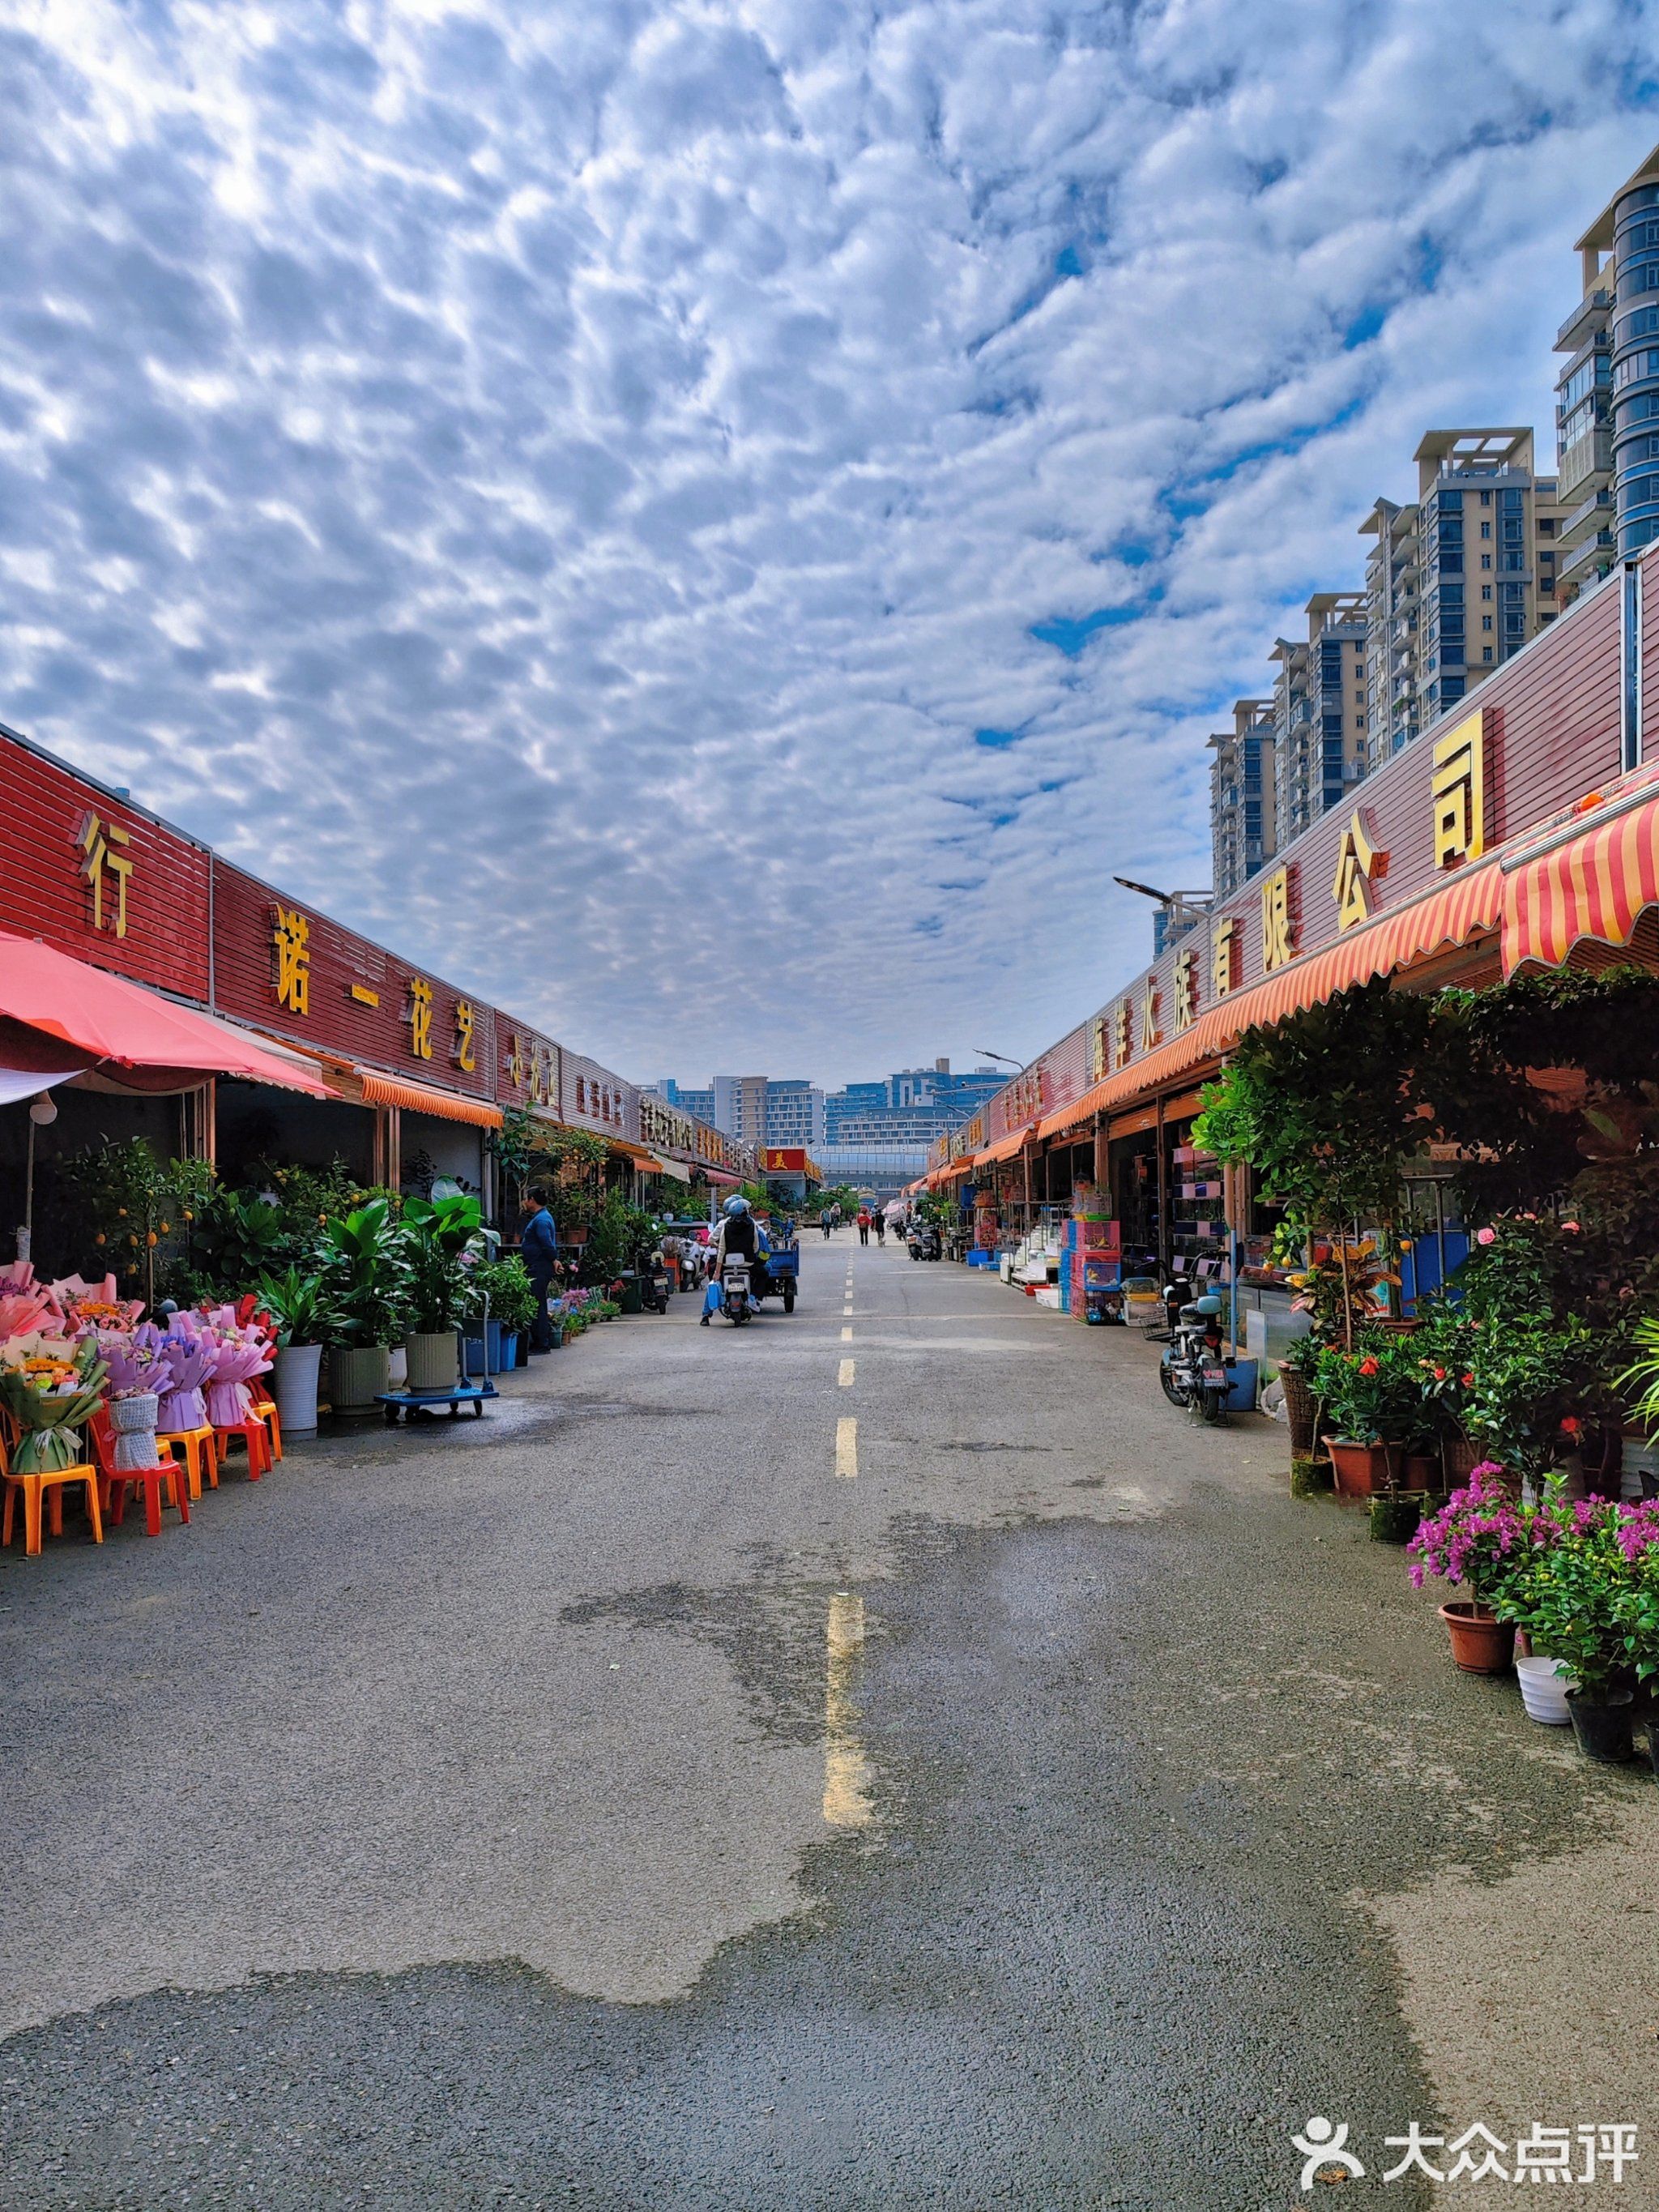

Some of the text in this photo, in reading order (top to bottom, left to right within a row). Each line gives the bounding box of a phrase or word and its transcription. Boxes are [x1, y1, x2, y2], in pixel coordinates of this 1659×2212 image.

[77, 810, 134, 939] 行
[270, 902, 477, 1072] 诺一花艺
